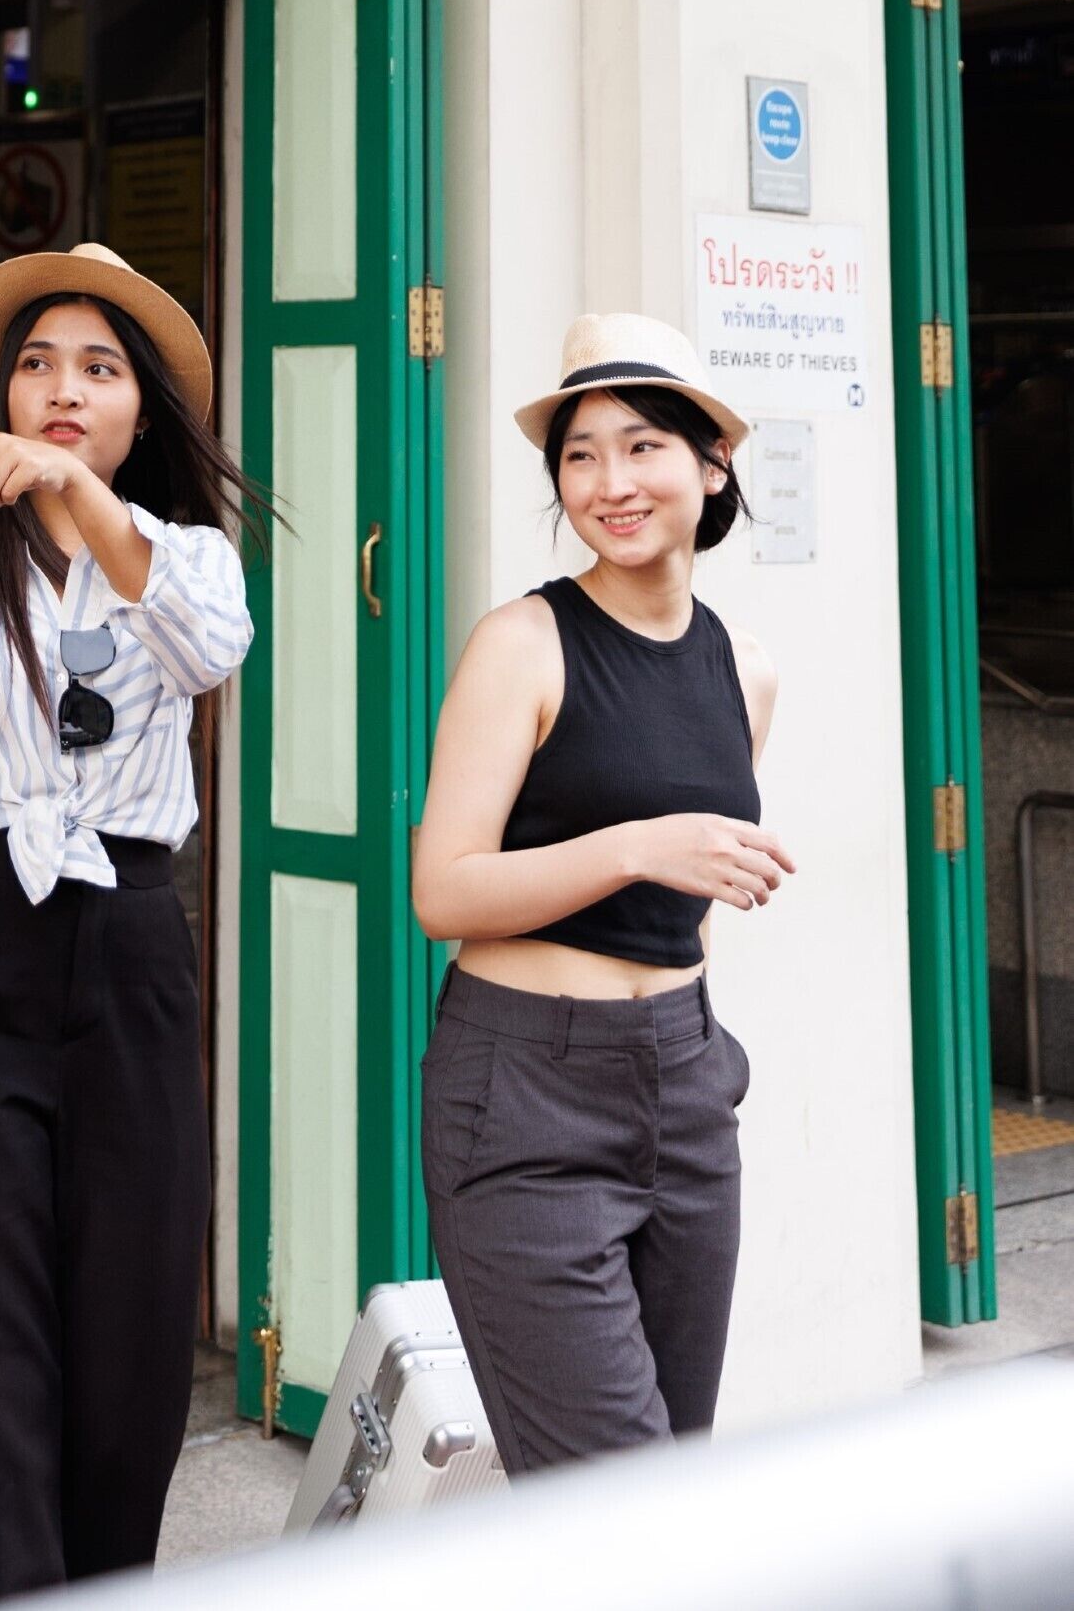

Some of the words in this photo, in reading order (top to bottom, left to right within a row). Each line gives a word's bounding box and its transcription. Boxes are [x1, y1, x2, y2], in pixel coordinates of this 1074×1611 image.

[703, 237, 835, 293] โปรดระวัง
[722, 303, 846, 340] ทรัพย์สินสูญหาย
[709, 349, 772, 369] BEWARE
[776, 352, 796, 370] OF
[800, 354, 858, 372] THIEVES
